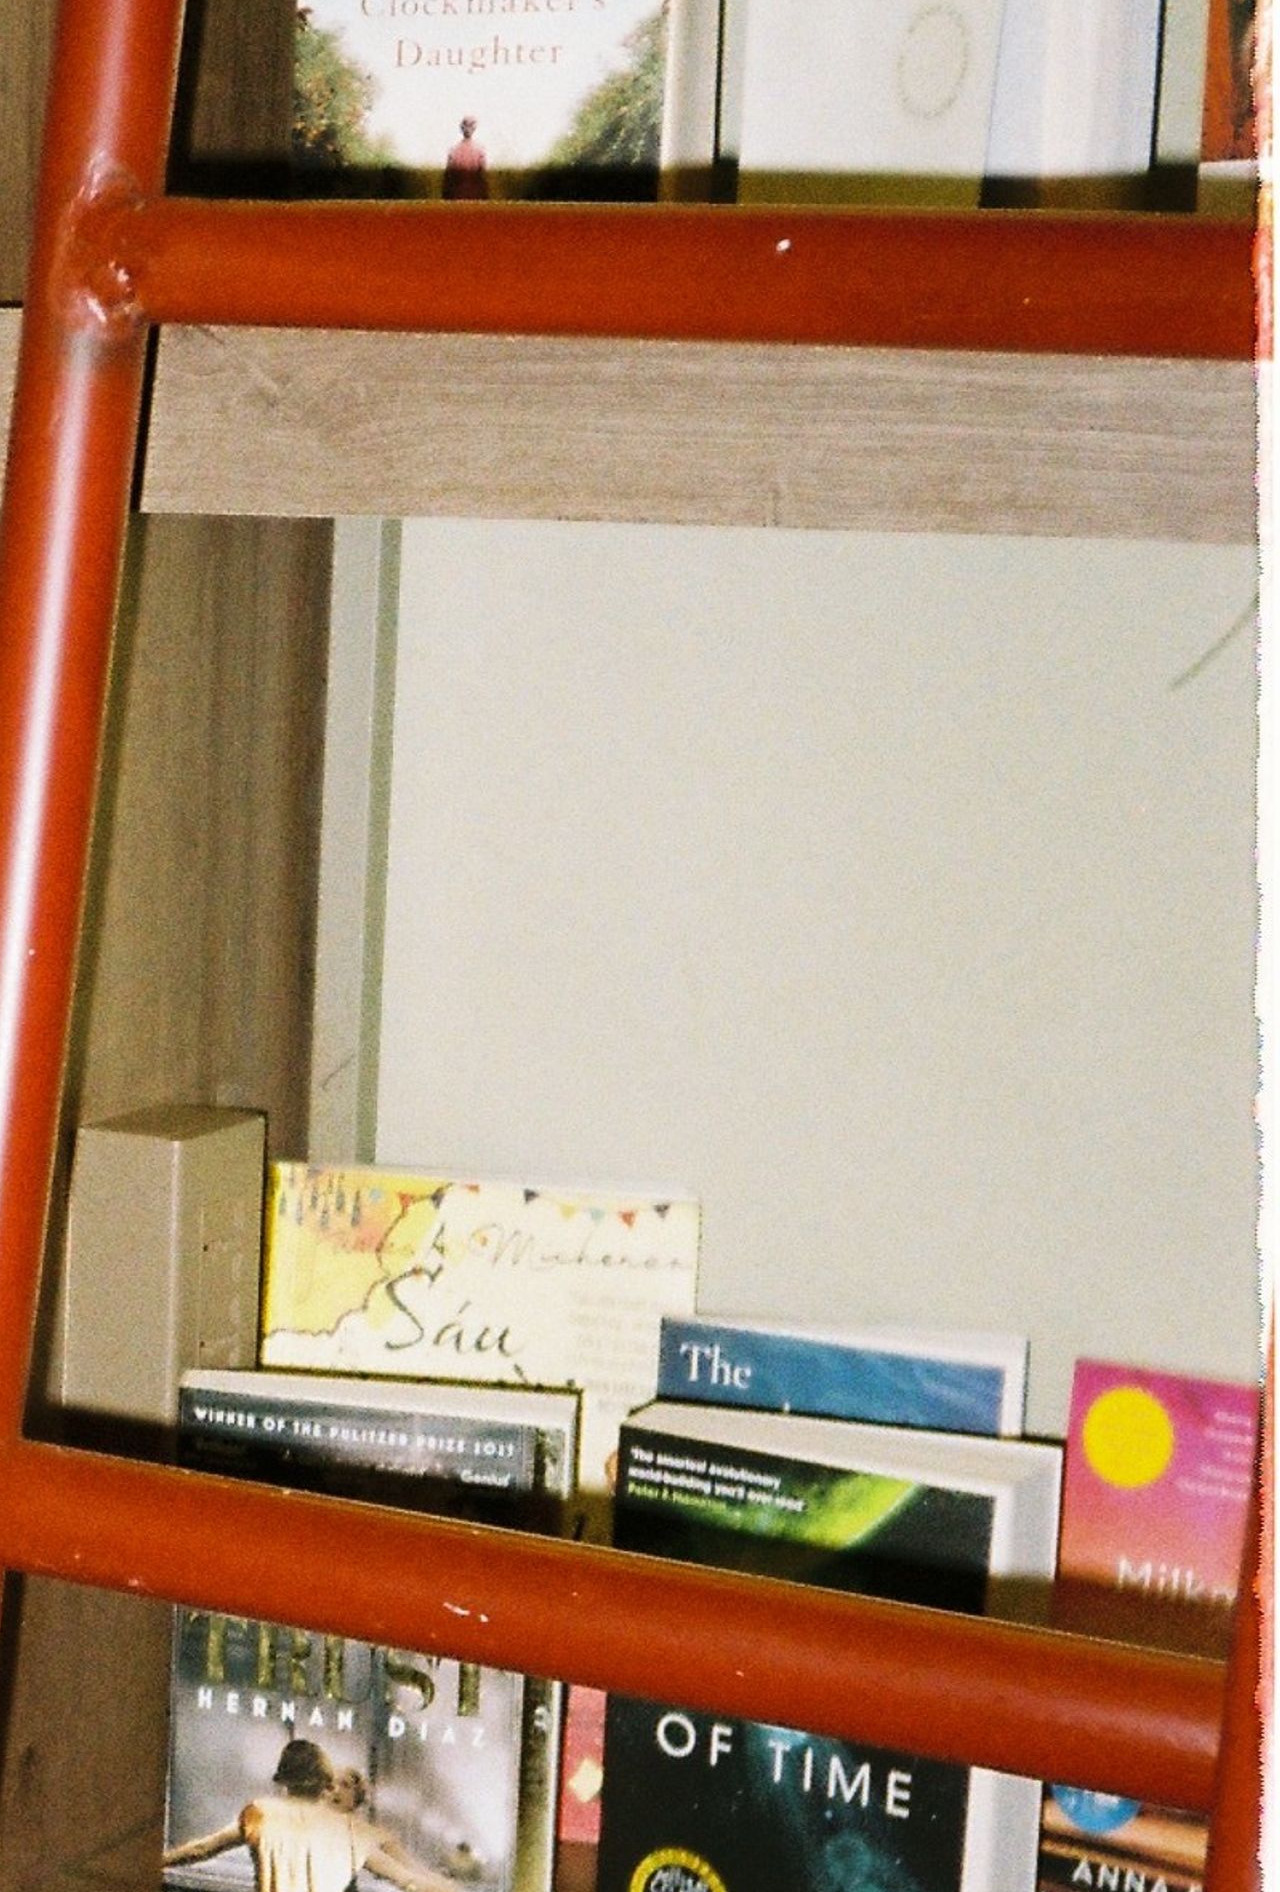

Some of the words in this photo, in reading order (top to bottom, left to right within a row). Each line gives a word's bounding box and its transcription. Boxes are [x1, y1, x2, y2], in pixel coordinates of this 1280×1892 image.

[395, 34, 563, 76] Daughter
[679, 1339, 752, 1389] The
[193, 1405, 256, 1430] WINNER
[262, 1415, 287, 1434] OF
[292, 1420, 322, 1439] THE
[328, 1423, 408, 1448] PULITZER
[415, 1433, 466, 1454] PRIZE
[1117, 1556, 1238, 1603] Milkm
[196, 1686, 355, 1731] HERNAN
[387, 1715, 488, 1747] DIAZ
[655, 1711, 734, 1768] OF
[767, 1738, 914, 1820] TIME
